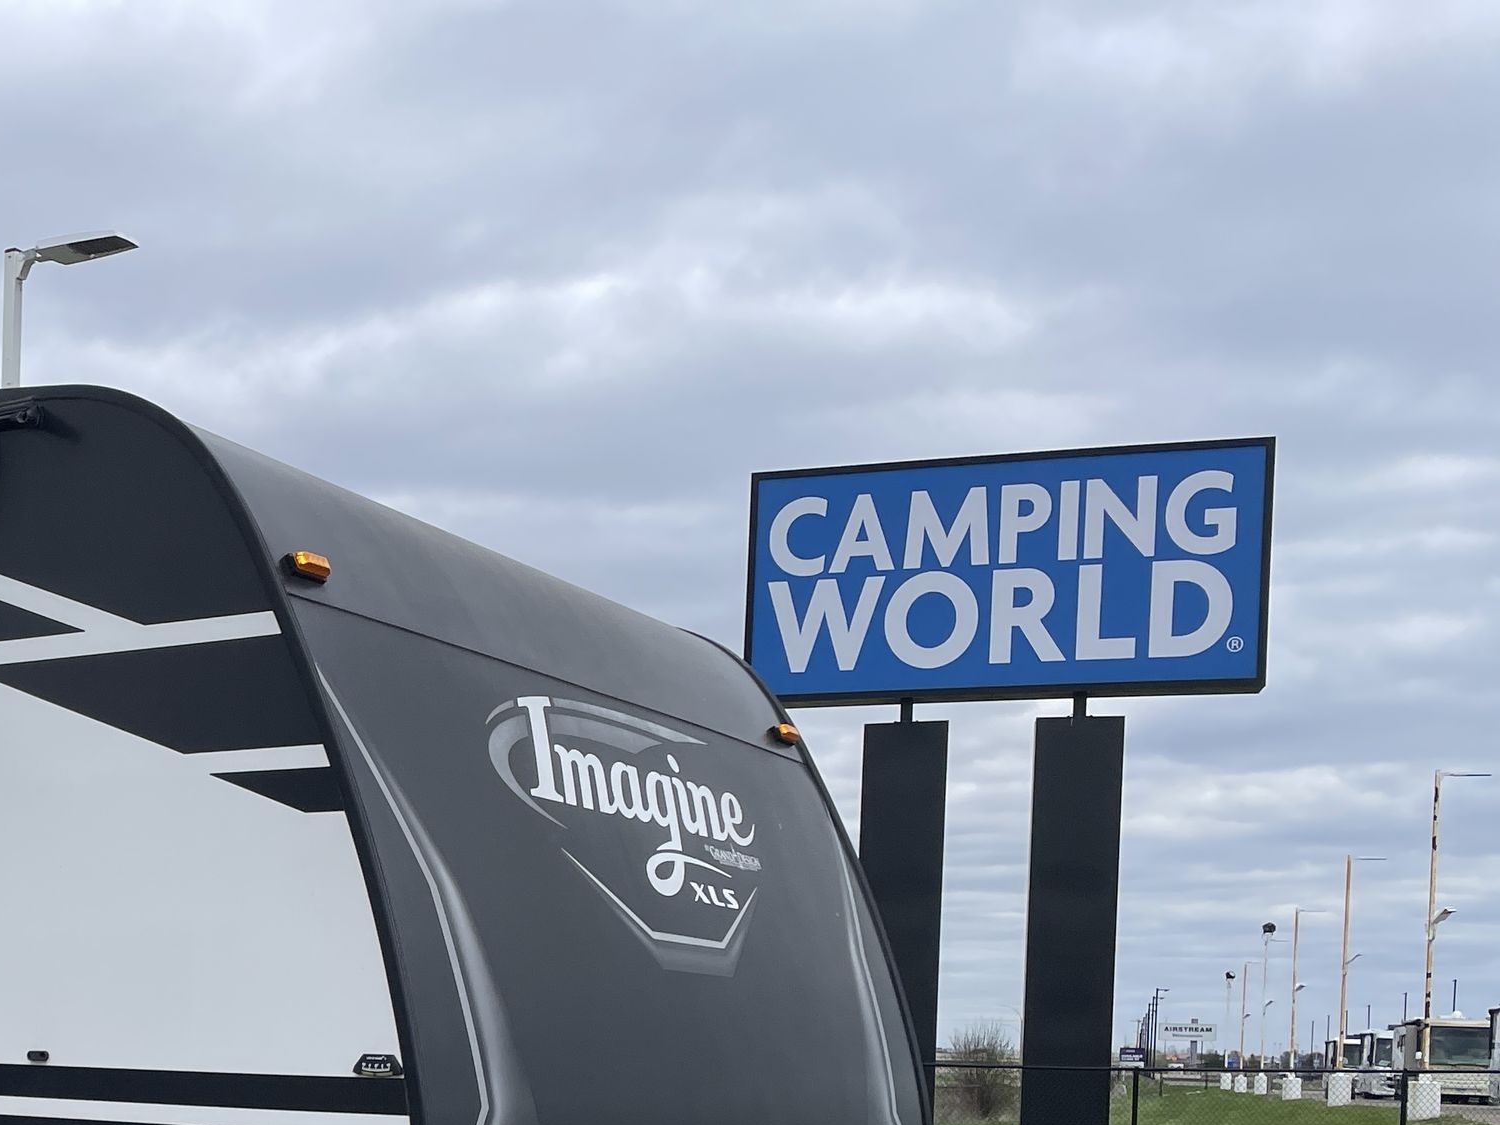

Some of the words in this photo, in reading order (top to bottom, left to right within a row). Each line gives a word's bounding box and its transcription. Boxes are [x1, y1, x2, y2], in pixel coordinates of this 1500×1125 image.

[769, 469, 1237, 577] CAMPING
[768, 559, 1234, 673] WORLD
[517, 696, 755, 896] Imagine
[690, 881, 739, 909] XLS
